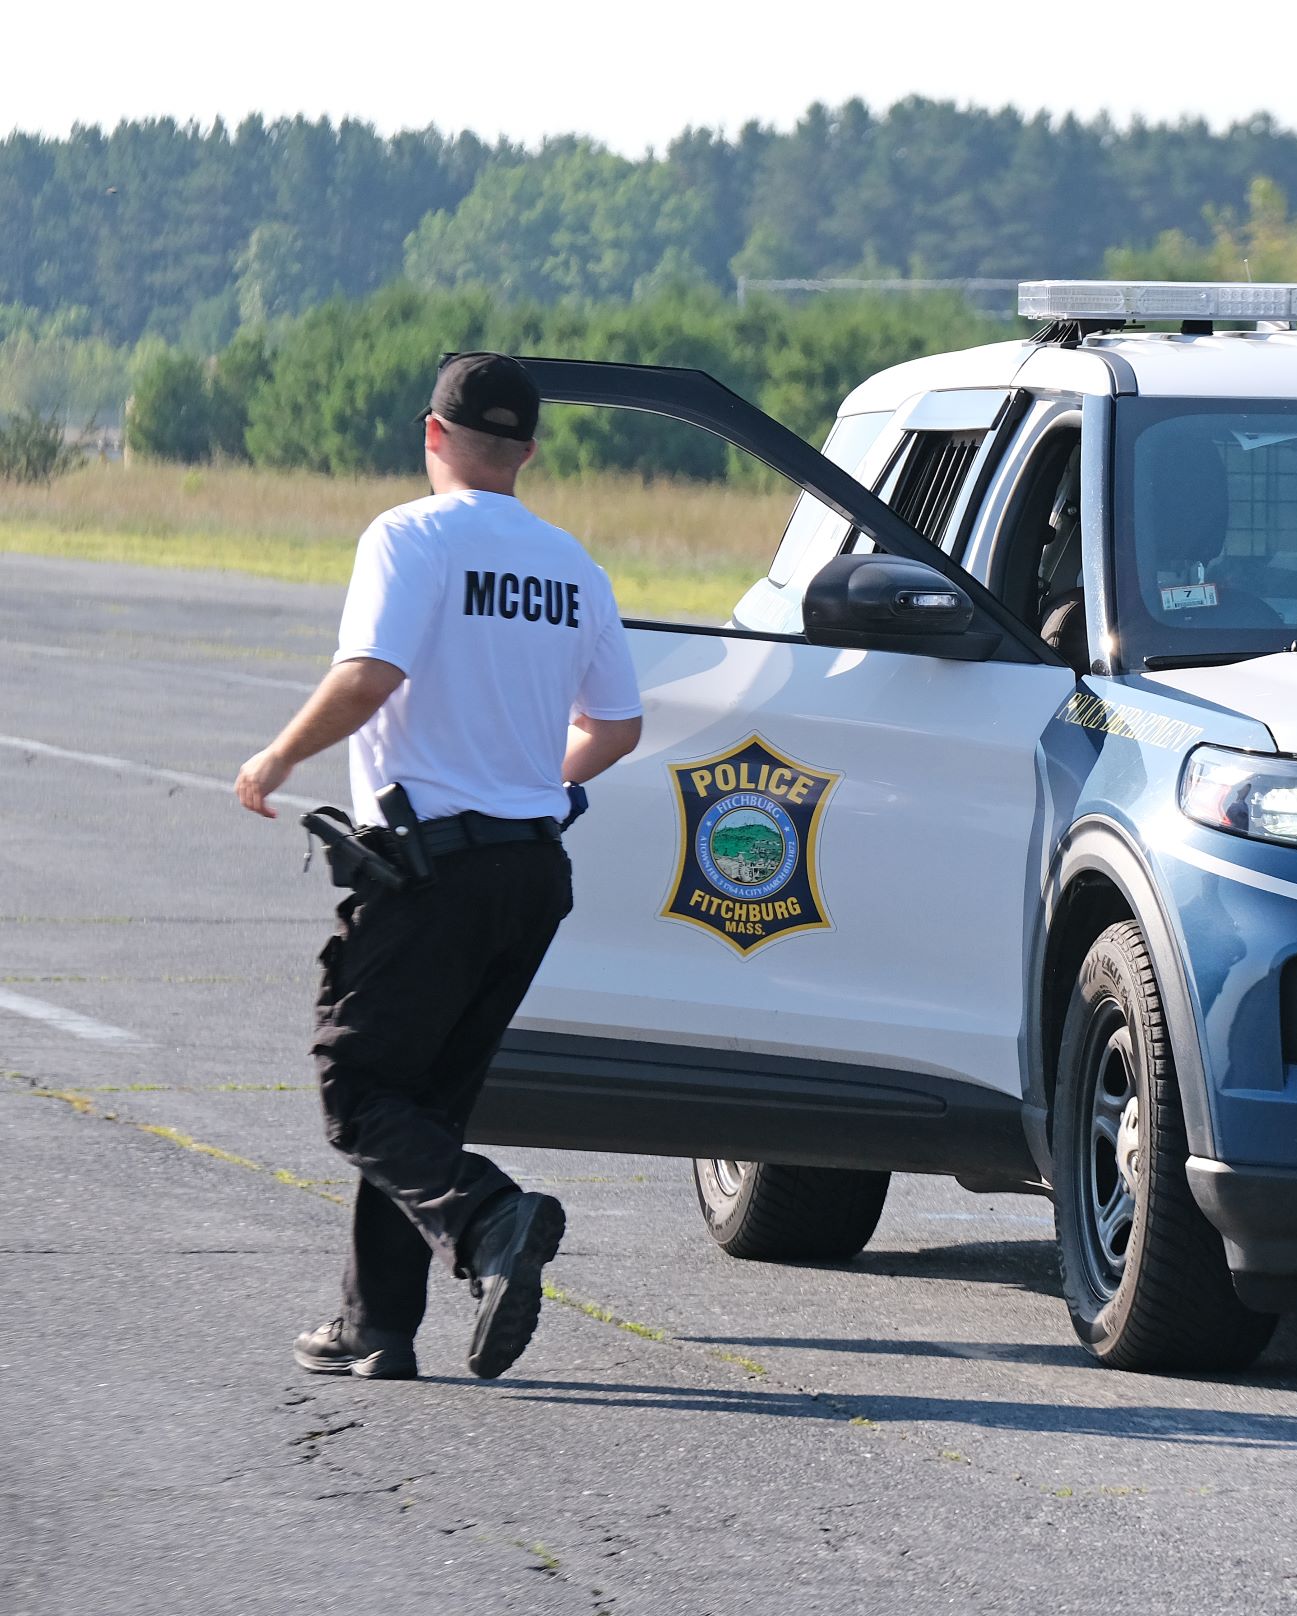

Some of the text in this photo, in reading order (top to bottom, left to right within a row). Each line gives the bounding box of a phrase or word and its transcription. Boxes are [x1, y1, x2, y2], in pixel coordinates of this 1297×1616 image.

[464, 570, 579, 628] MCCUE
[1184, 590, 1192, 598] 7
[1056, 692, 1204, 752] POLICE DEPARTMENT
[690, 762, 815, 805] POLICE
[716, 795, 783, 818] FITCHBURG
[700, 842, 712, 868] TOWN
[763, 872, 786, 892] MARCH
[689, 889, 802, 922] FITCHBURG
[725, 920, 766, 936] MASS.
